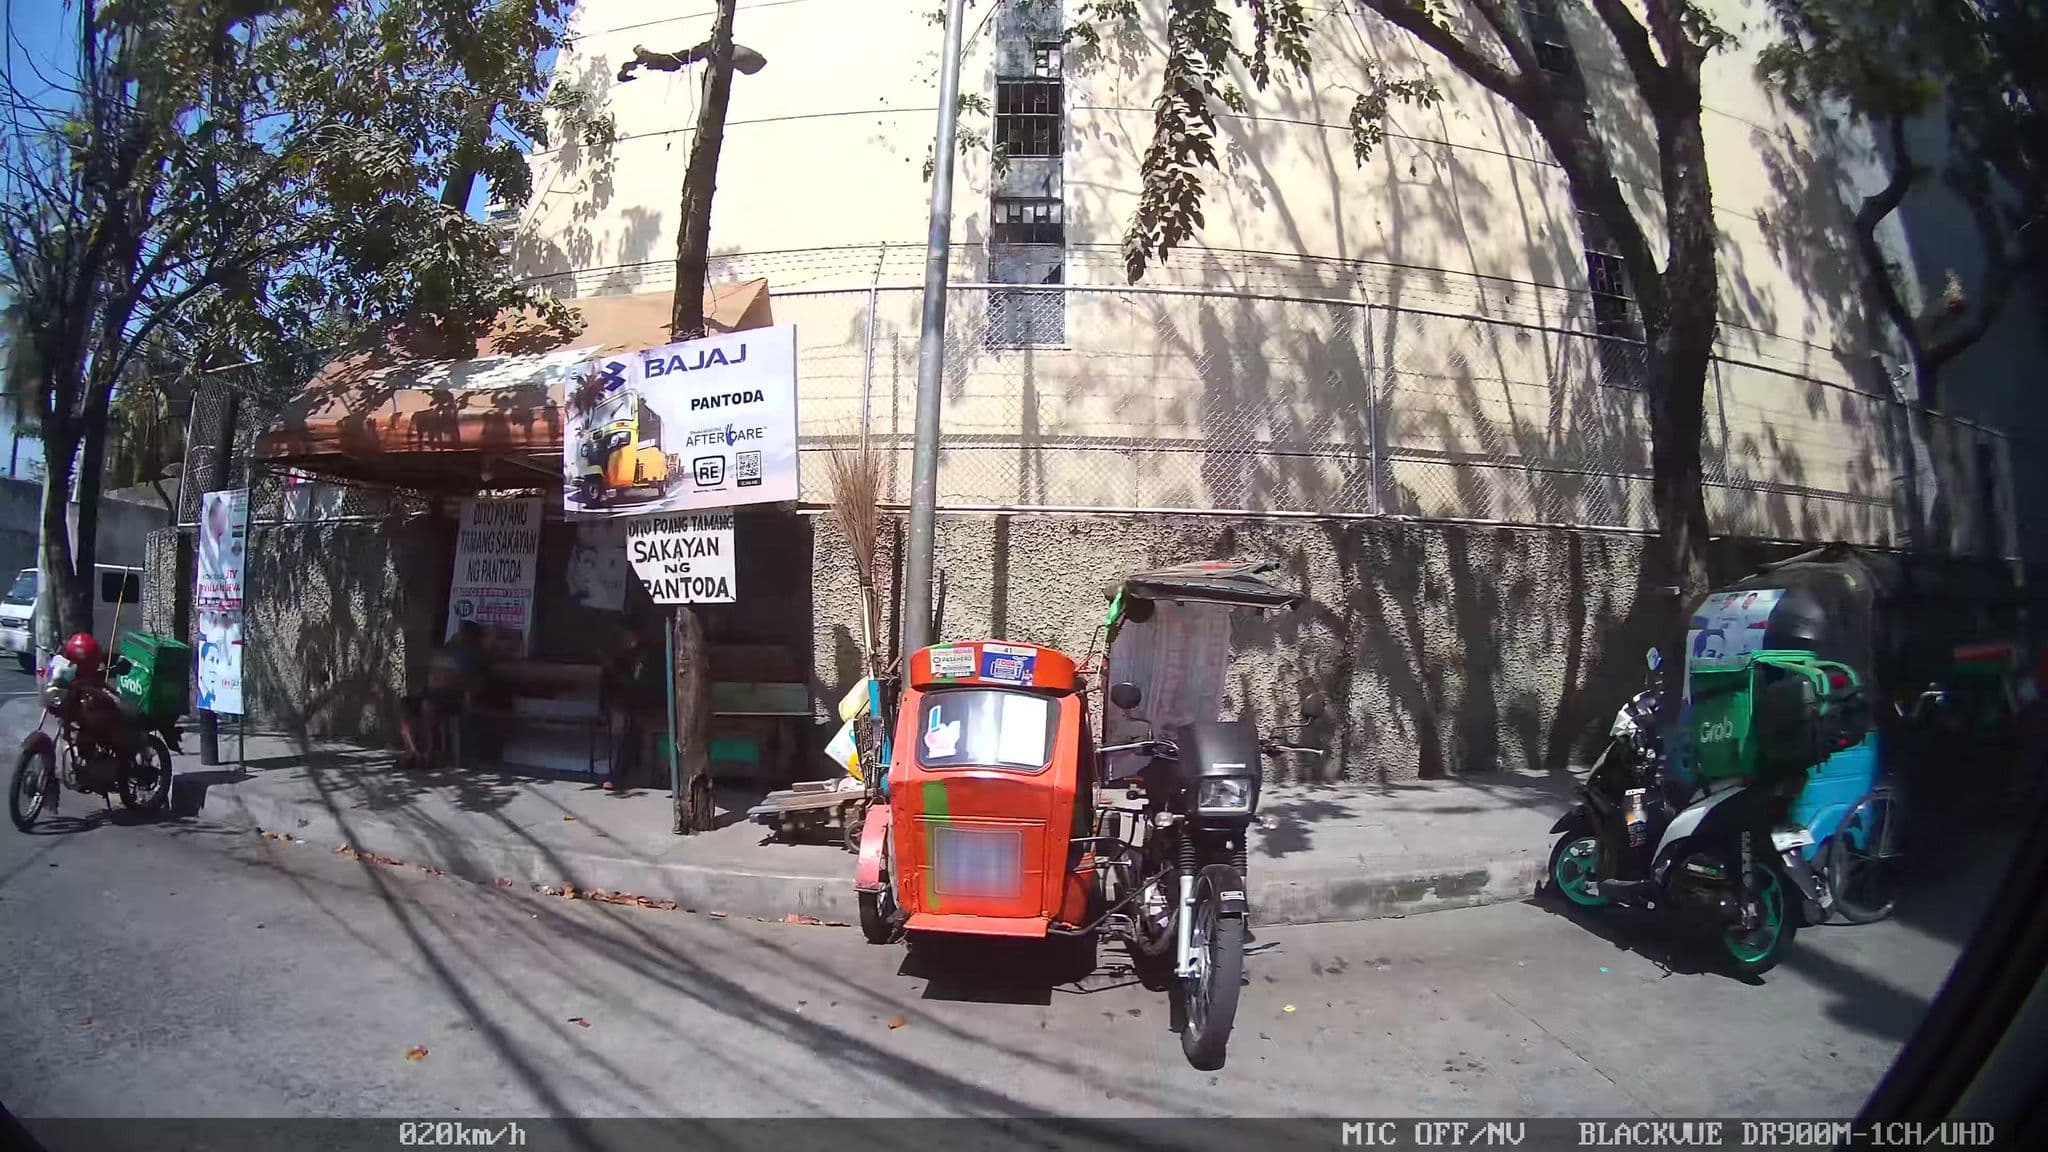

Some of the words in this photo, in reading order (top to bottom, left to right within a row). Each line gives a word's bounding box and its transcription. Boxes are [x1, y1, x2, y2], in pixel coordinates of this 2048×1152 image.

[645, 344, 747, 378] BAJAJ
[691, 390, 765, 411] PANTODA
[700, 466, 719, 480] RE
[691, 514, 734, 531] TAMANG
[496, 530, 537, 555] SAKAYAN
[634, 537, 719, 563] SAKAYAN
[467, 560, 480, 583] NG
[481, 559, 521, 583] PANTODA
[664, 562, 691, 574] NG
[640, 576, 729, 599] PANTODA
[119, 675, 143, 696] Grab
[1701, 716, 1733, 743] Grab
